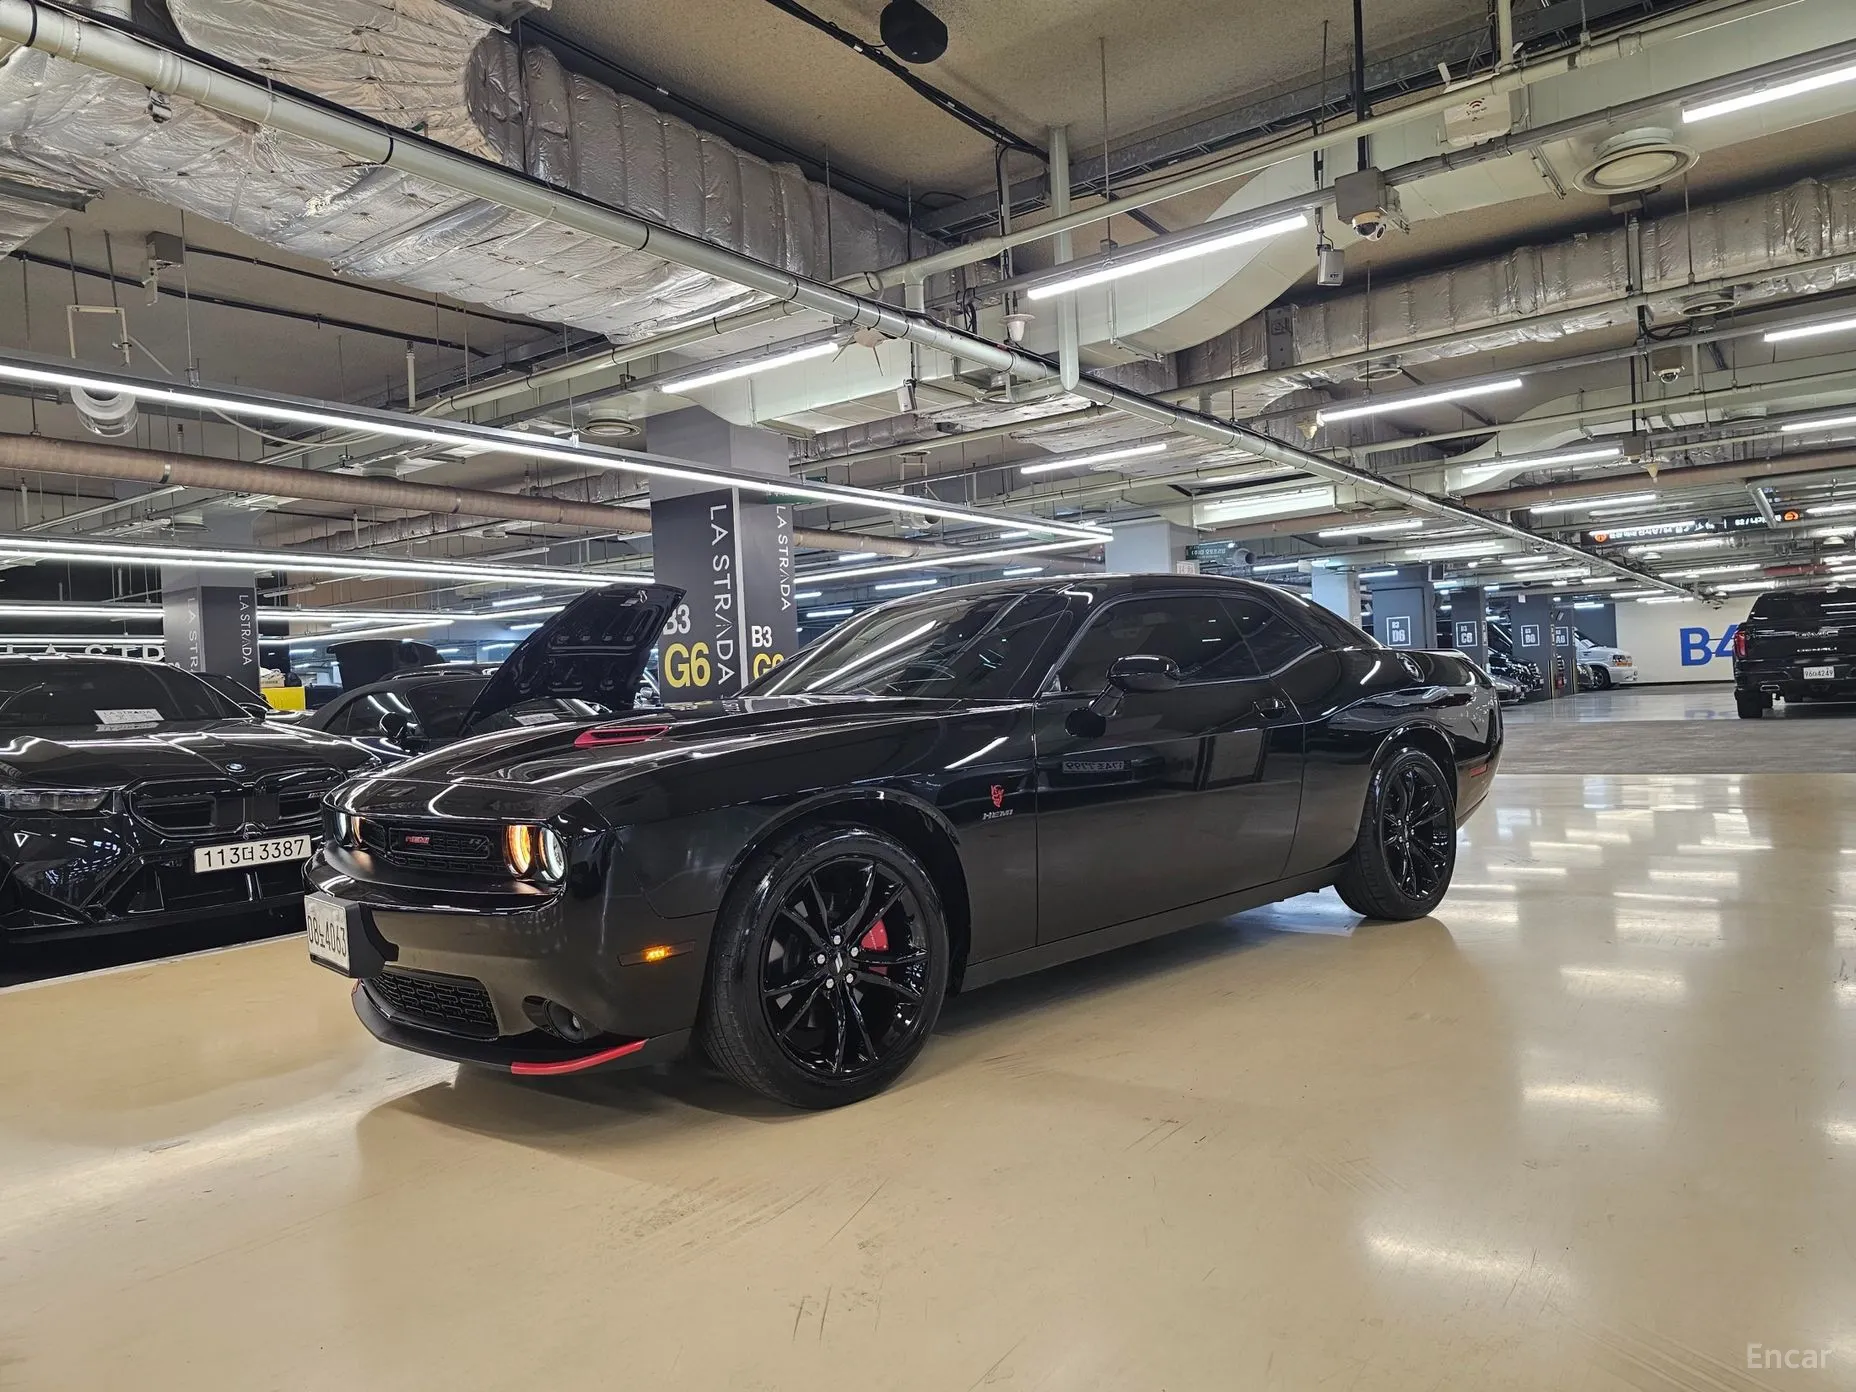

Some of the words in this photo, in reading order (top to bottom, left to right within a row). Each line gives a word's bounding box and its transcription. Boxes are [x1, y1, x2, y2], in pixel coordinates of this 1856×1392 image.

[709, 504, 729, 546] LA
[776, 505, 788, 529] LA
[778, 535, 792, 611] STRADA
[239, 594, 250, 611] LA
[713, 554, 736, 686] STRADA
[751, 625, 773, 648] B3
[664, 641, 711, 689] G6
[204, 846, 255, 868] 113더
[259, 839, 305, 861] 3387
